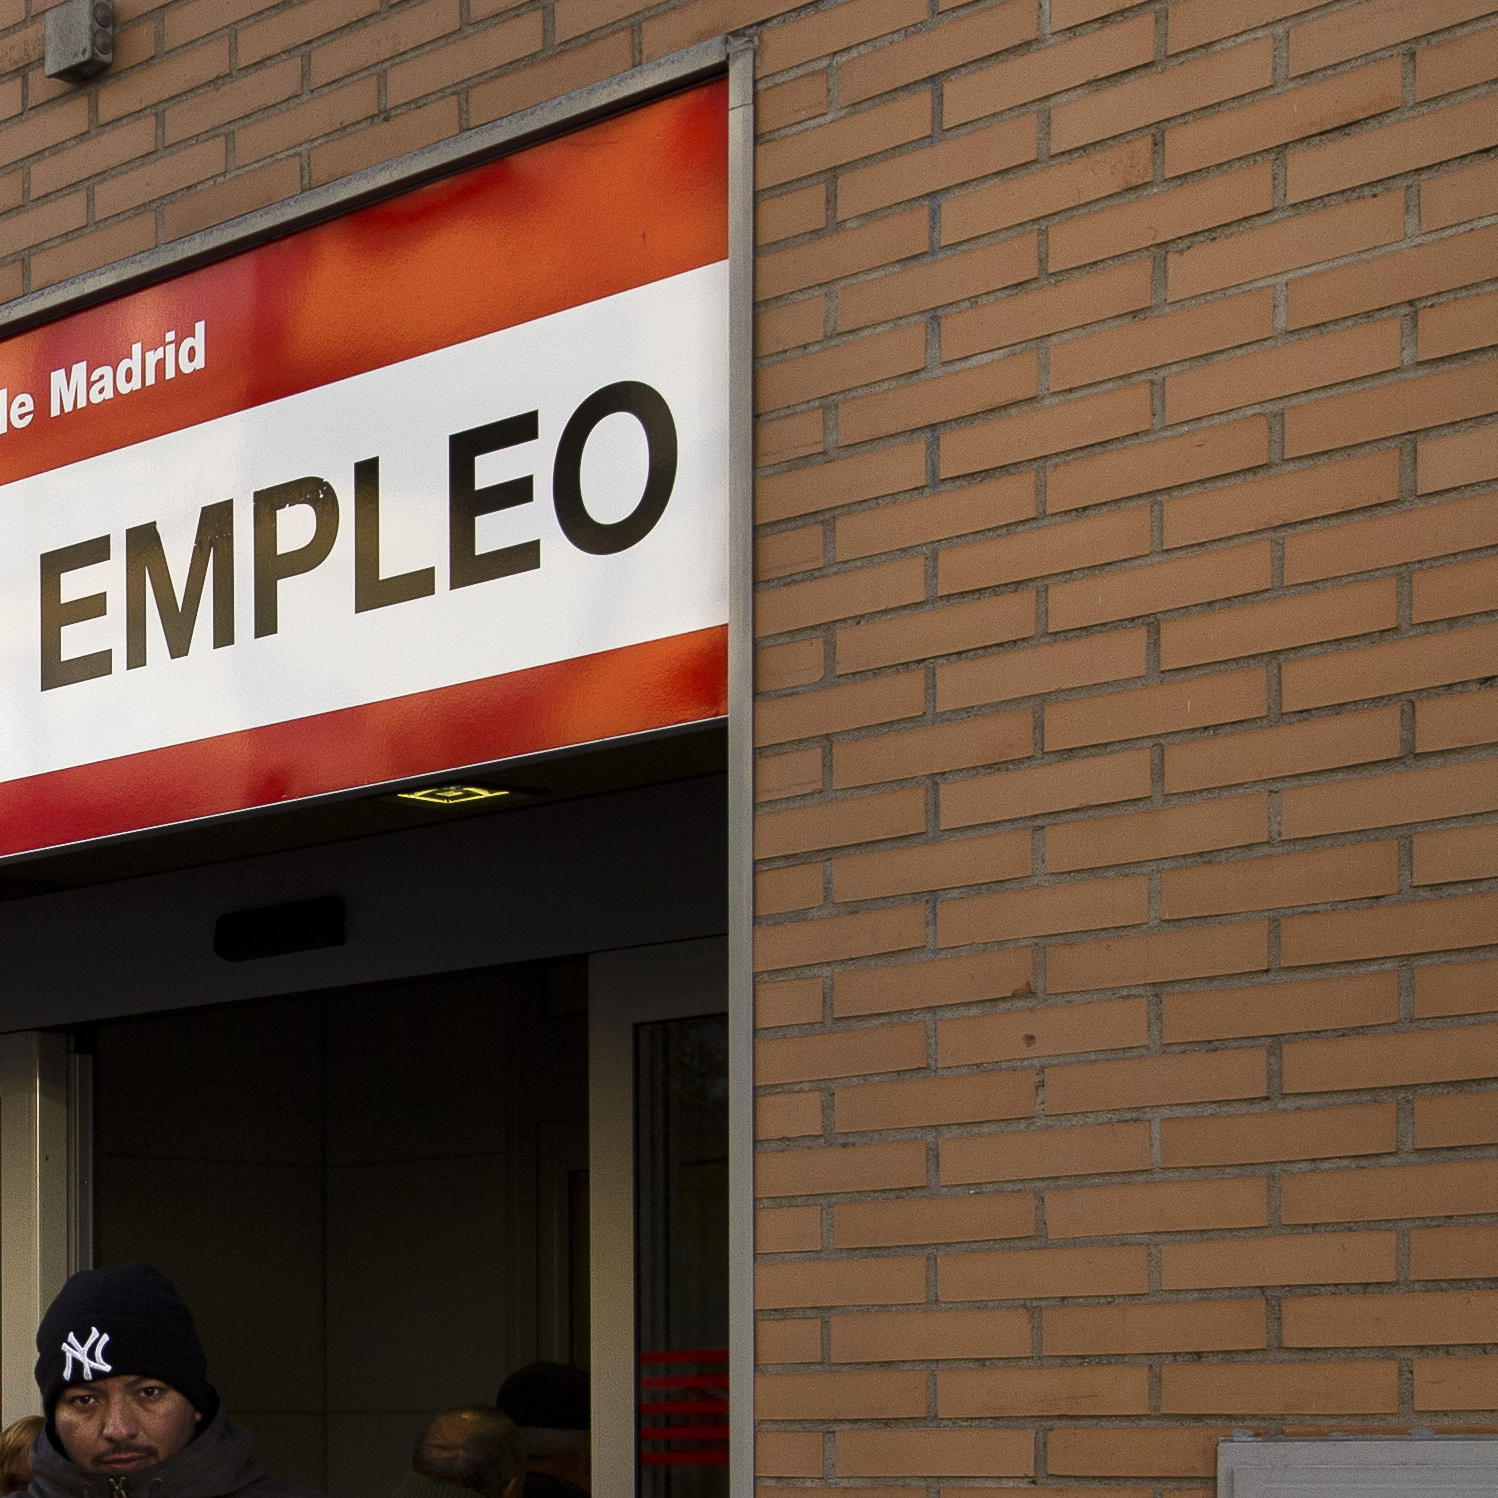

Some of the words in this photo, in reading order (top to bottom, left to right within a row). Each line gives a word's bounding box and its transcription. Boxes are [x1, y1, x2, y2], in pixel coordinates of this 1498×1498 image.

[50, 319, 207, 418] Madrid
[39, 380, 679, 692] EMPLEO
[61, 1326, 112, 1381] NY
